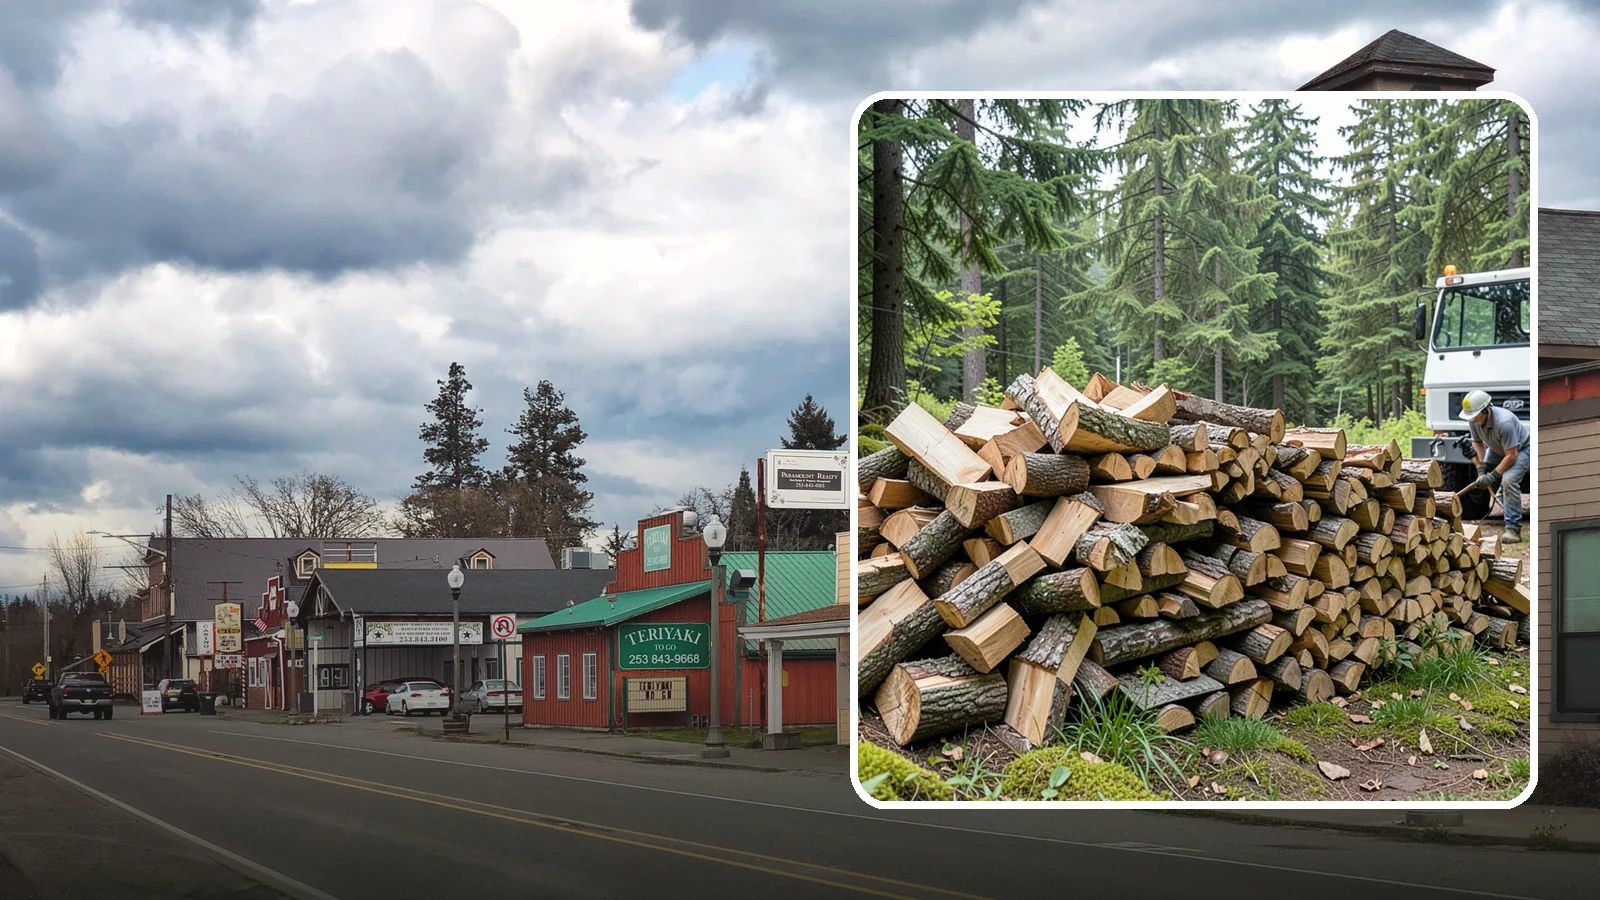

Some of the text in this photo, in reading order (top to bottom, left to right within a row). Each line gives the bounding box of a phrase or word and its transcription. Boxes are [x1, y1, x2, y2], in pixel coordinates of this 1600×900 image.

[781, 471, 839, 480] PARAMOUNT REALTY
[625, 627, 702, 646] TERIYAKI
[628, 654, 700, 664] 253 843-9668
[639, 681, 673, 691] TERIYAKI
